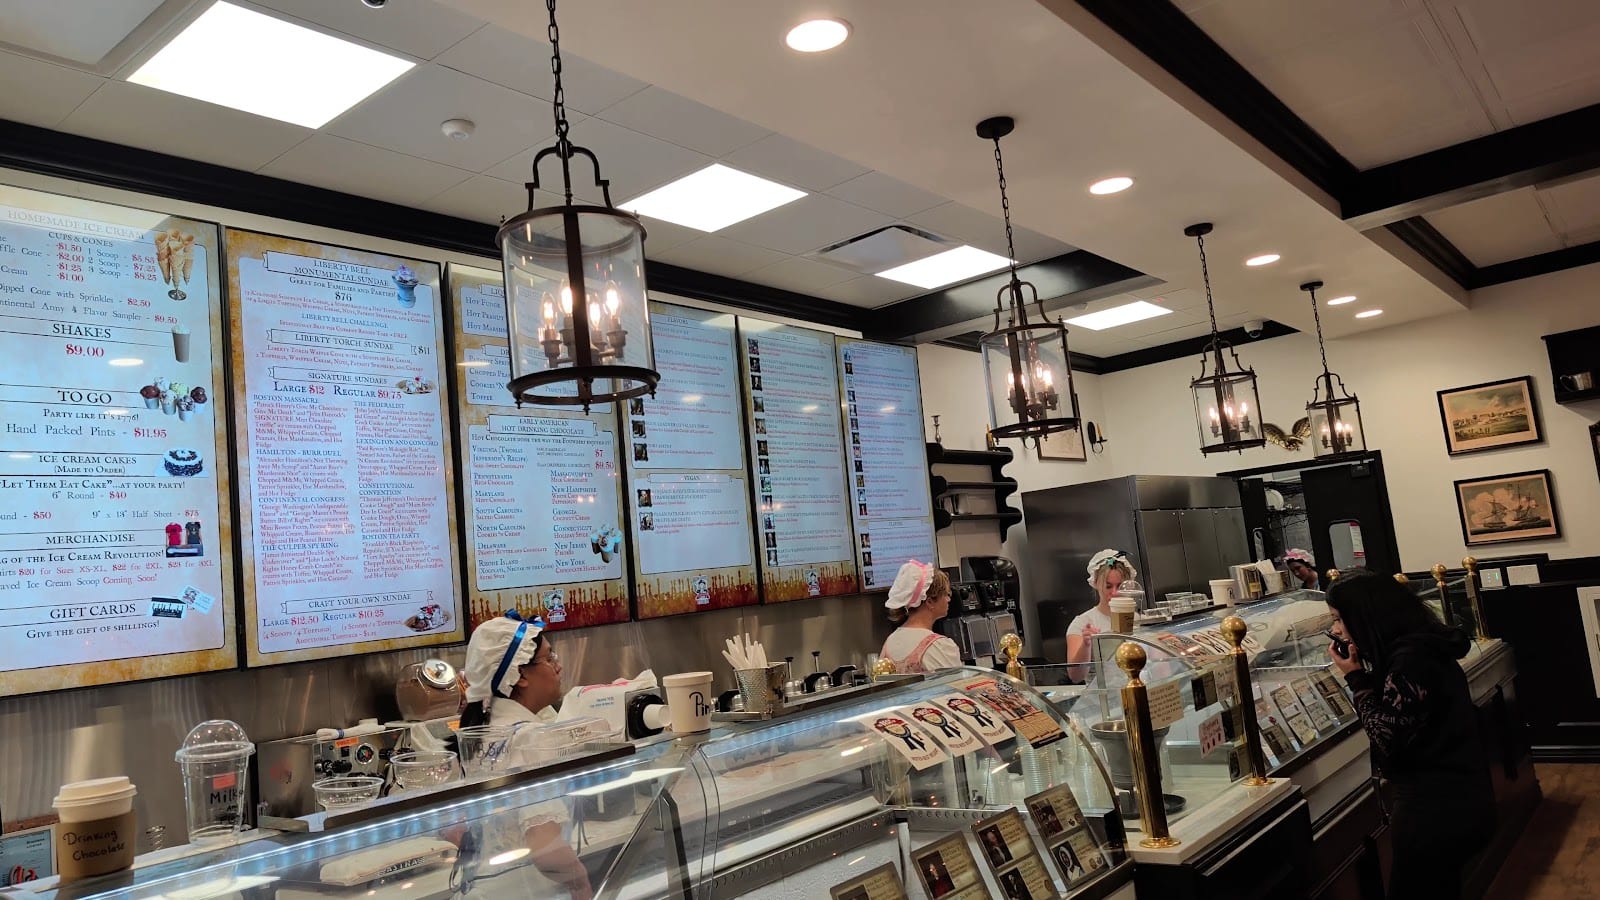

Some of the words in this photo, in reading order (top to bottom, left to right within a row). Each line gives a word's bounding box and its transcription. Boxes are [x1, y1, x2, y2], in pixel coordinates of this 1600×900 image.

[48, 231, 72, 241] CUPS
[82, 236, 113, 247] CONES
[21, 247, 42, 257] Cone
[96, 247, 119, 260] Scoop
[88, 256, 94, 264] 2
[98, 258, 120, 270] Scoop
[313, 260, 350, 272] LIBERTY
[350, 265, 371, 275] BELL
[0, 264, 28, 276] Cream
[99, 267, 121, 279] Scoop
[294, 266, 357, 281] MONUMENTAL
[357, 276, 390, 287] SUNDAE
[30, 286, 51, 296] Cone
[56, 290, 74, 299] with
[79, 292, 114, 304] Sprinkles
[127, 298, 151, 307] $2.50
[335, 291, 352, 302] $76
[83, 306, 108, 317] Flavor
[112, 310, 141, 322] Sampler
[466, 309, 480, 318] HOT
[302, 313, 330, 322] LIBERTY
[331, 316, 349, 324] BELL
[349, 318, 389, 329] CHALLENGE
[467, 321, 481, 330] HOT
[52, 323, 111, 338] SHAKES
[66, 343, 104, 357] $9.00
[295, 333, 330, 344] LIBERTY
[334, 338, 360, 347] TORCH
[364, 341, 394, 350] SUNDAE
[418, 345, 430, 355] $11
[308, 372, 352, 382] SIGNATURE
[354, 376, 387, 385] SUNDAES
[57, 390, 83, 403] TO
[87, 392, 112, 404] GO
[273, 381, 307, 393] LARGE
[308, 384, 325, 395] $12
[334, 385, 376, 398] REGULAR
[377, 388, 402, 400] $9.75
[284, 395, 319, 404] MASSACRE
[368, 401, 405, 409] FEDERALIST
[43, 408, 73, 418] PARTY
[540, 419, 569, 427] AMERICAN
[7, 423, 37, 434] Hand
[45, 424, 82, 436] Packed
[90, 426, 116, 437] Pints
[133, 427, 167, 438] $11.95
[517, 425, 548, 433] DRINKING
[549, 427, 584, 435] CHOCOLATE
[356, 438, 394, 446] LEXINGTON
[409, 439, 439, 447] CONCORD
[471, 433, 484, 441] HOT
[256, 448, 297, 456] HAMILTON
[594, 448, 604, 457] $7
[39, 455, 58, 463] ICE
[62, 455, 100, 464] CREAM
[104, 456, 137, 465] CAKES
[26, 479, 57, 489] THEM
[60, 480, 79, 489] EAT
[158, 481, 186, 489] PARTY!
[67, 491, 95, 500] Round
[109, 491, 127, 499] $40
[33, 511, 52, 520] $50
[132, 510, 149, 518] Half
[153, 510, 172, 518] Sheet
[476, 524, 498, 532] NORTH
[46, 533, 135, 545] MERCHANDISE
[10, 556, 23, 564] OF
[26, 555, 45, 563] THE
[48, 553, 65, 562] ICE
[67, 552, 101, 561] CREAM
[104, 549, 164, 560] REVOLUTION!
[555, 559, 569, 567] NEW
[570, 558, 585, 567] YORK
[18, 568, 35, 576] $20
[112, 563, 127, 571] $22
[27, 580, 40, 589] Ice
[45, 579, 72, 588] Cream
[76, 577, 100, 588] Scoop
[103, 576, 133, 586] Coming
[137, 573, 158, 582] Soon!
[308, 599, 334, 609] CRAFT
[337, 597, 359, 606] YOUR
[361, 596, 381, 604] OWN
[382, 594, 411, 602] SUNDAE
[50, 606, 87, 619] GIFT
[89, 603, 136, 616] CARDS
[262, 618, 289, 627] LARGE
[290, 615, 319, 626] $12.50
[322, 612, 357, 621] REGULAR
[26, 629, 53, 639] GIVE
[54, 629, 74, 637] THE
[76, 626, 97, 635] GIFT
[113, 620, 160, 632] SHILLINGS!
[63, 829, 118, 846] Drinking
[72, 841, 127, 862] Chocolate
